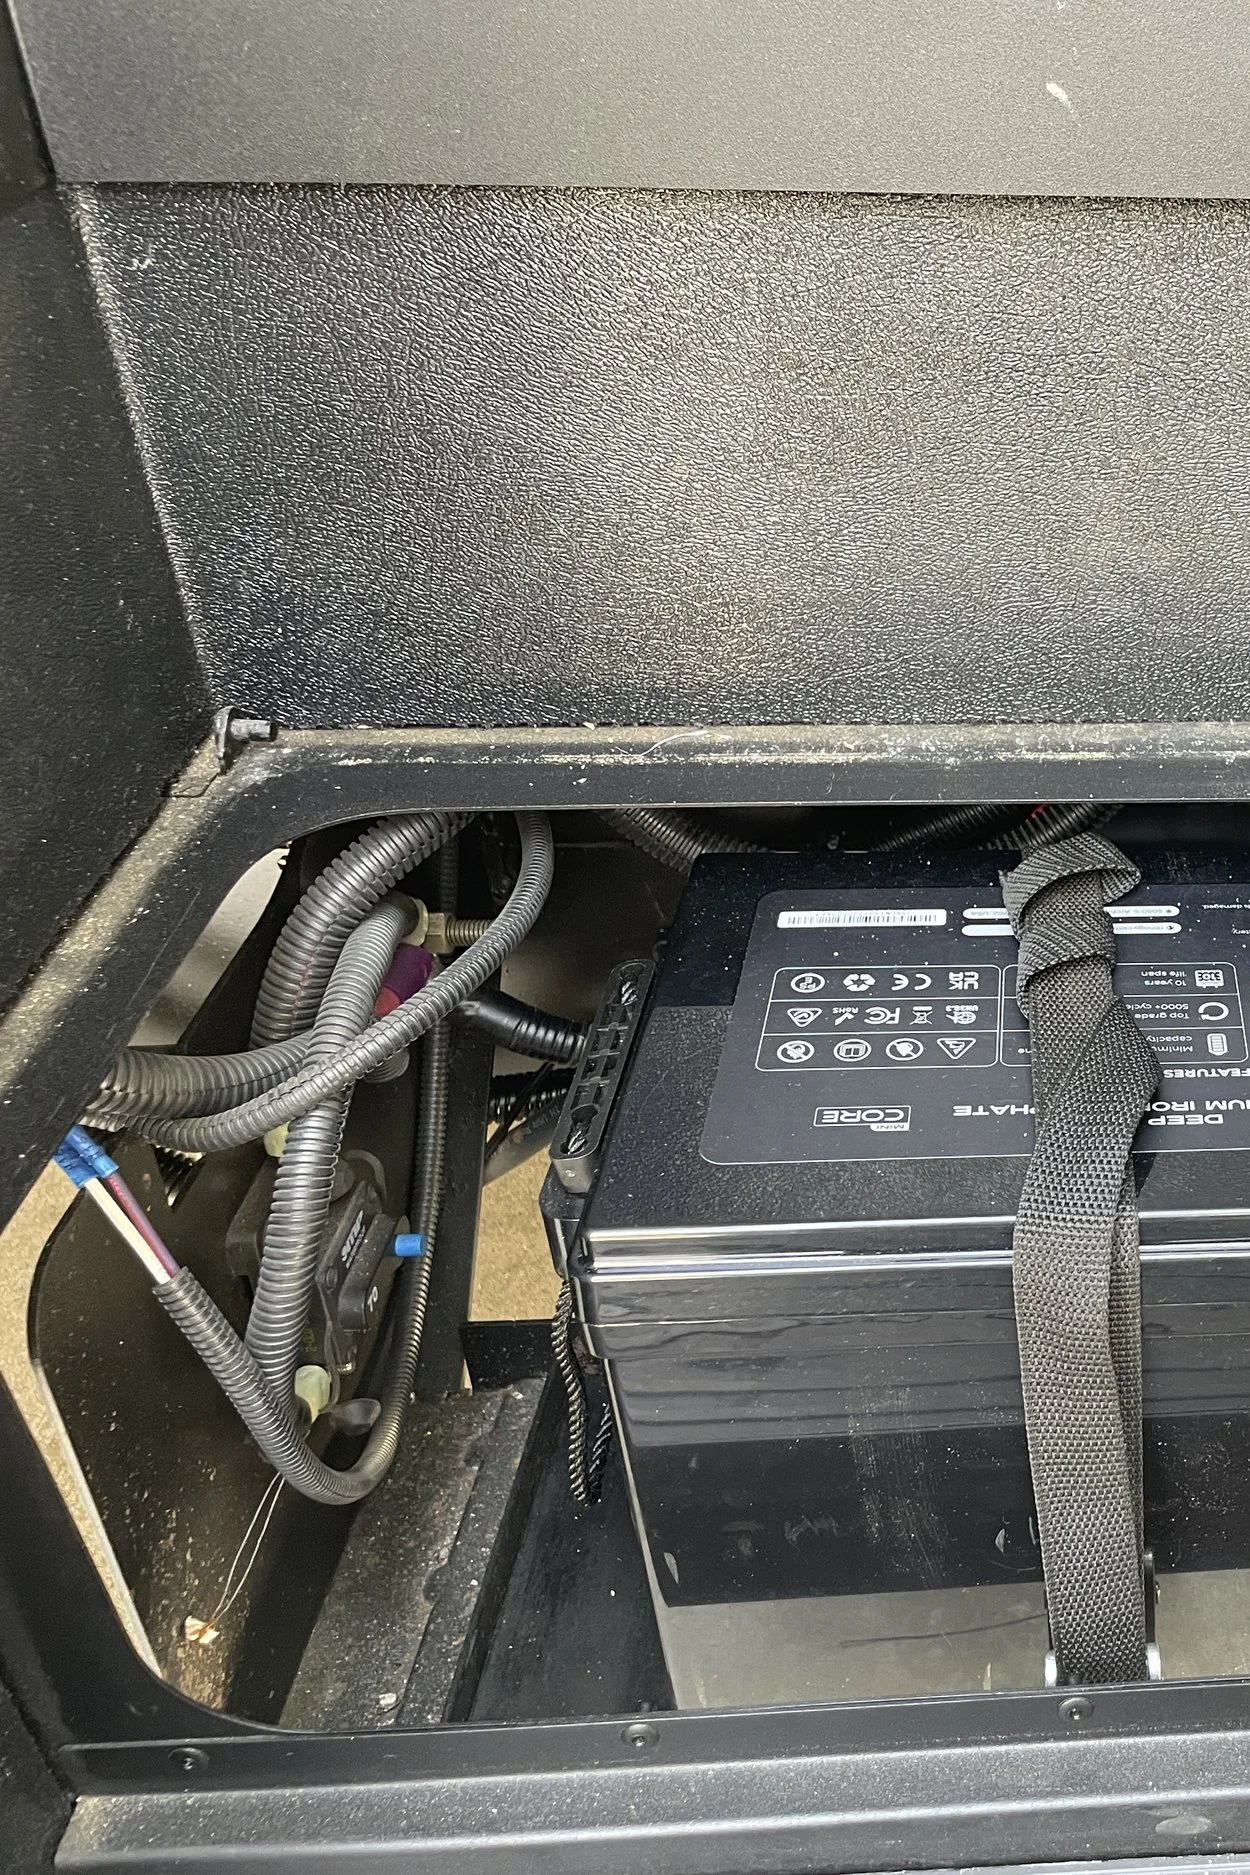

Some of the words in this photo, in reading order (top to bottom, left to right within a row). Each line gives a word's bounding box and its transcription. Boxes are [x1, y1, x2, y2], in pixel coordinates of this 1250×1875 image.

[1169, 970, 1185, 978] life
[891, 974, 932, 990] CE
[1144, 978, 1174, 986] years
[832, 1006, 859, 1014] RoHS
[1126, 1002, 1152, 1010] cycle
[1134, 1012, 1168, 1020] grade
[1169, 1012, 1190, 1020] Top
[1146, 1035, 1192, 1043] capacity
[1163, 1068, 1250, 1078] FEATURES
[822, 1108, 904, 1122] CORE
[1148, 1114, 1224, 1125] DEEP
